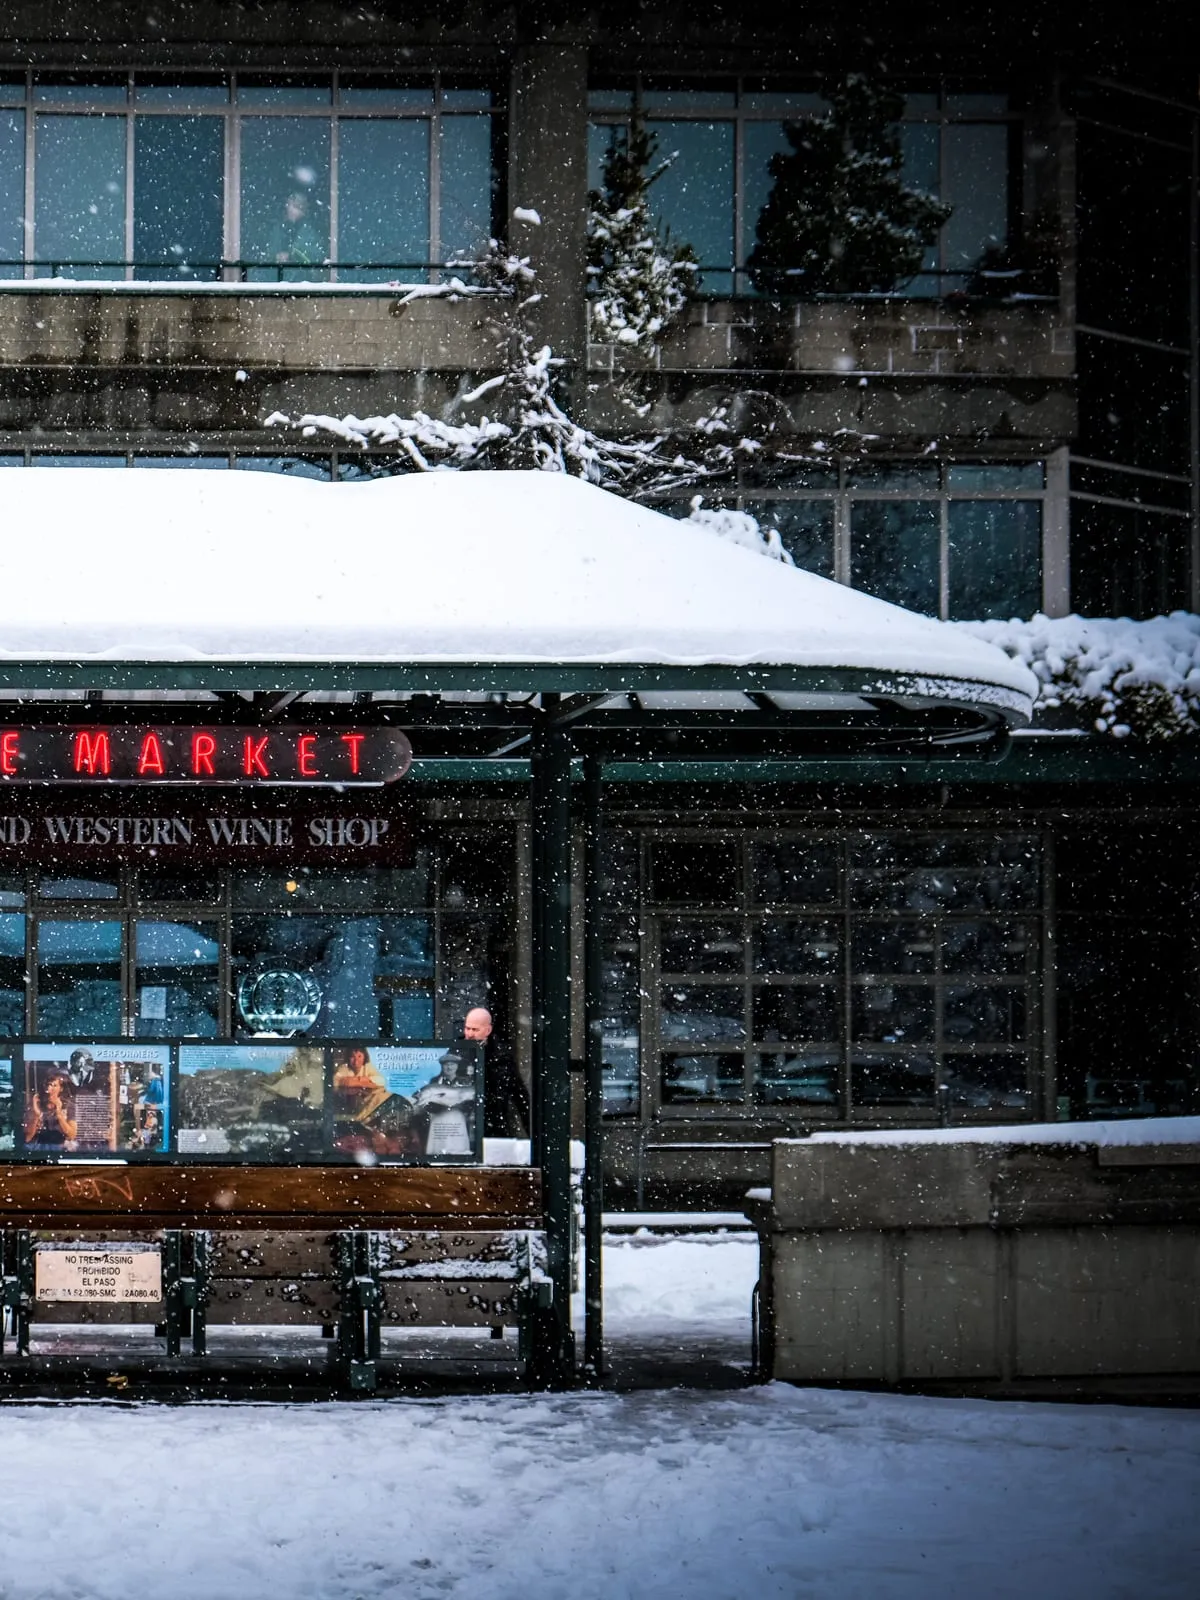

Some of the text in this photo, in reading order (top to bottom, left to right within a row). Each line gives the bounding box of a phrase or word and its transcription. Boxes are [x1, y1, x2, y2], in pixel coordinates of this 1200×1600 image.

[74, 731, 365, 777] MARKET
[44, 816, 193, 845] WESTERN
[206, 817, 293, 846] WINE
[308, 817, 388, 846] SHOP
[95, 1048, 160, 1059] PERFORMERS
[376, 1051, 439, 1061] COMMERCIAL
[65, 1256, 77, 1265] NO
[82, 1278, 116, 1286] EL PASO
